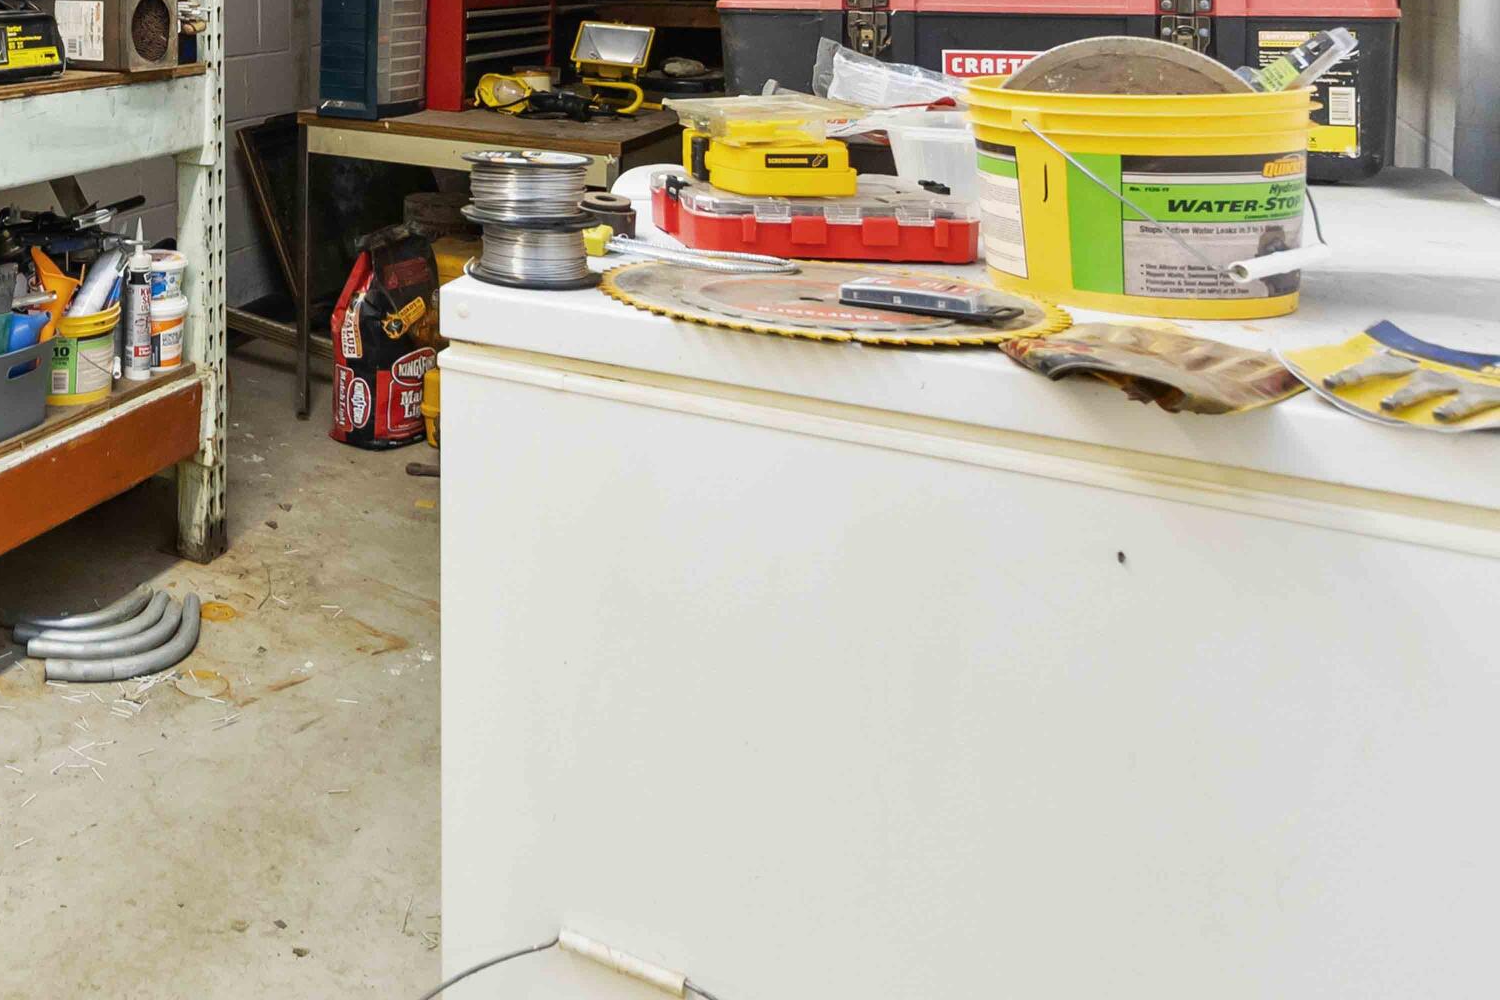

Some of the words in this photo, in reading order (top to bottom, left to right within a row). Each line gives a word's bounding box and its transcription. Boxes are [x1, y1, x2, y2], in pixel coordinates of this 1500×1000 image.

[951, 57, 1030, 74] CRAFT
[1167, 196, 1301, 214] WATER-STOP
[52, 346, 70, 358] 10
